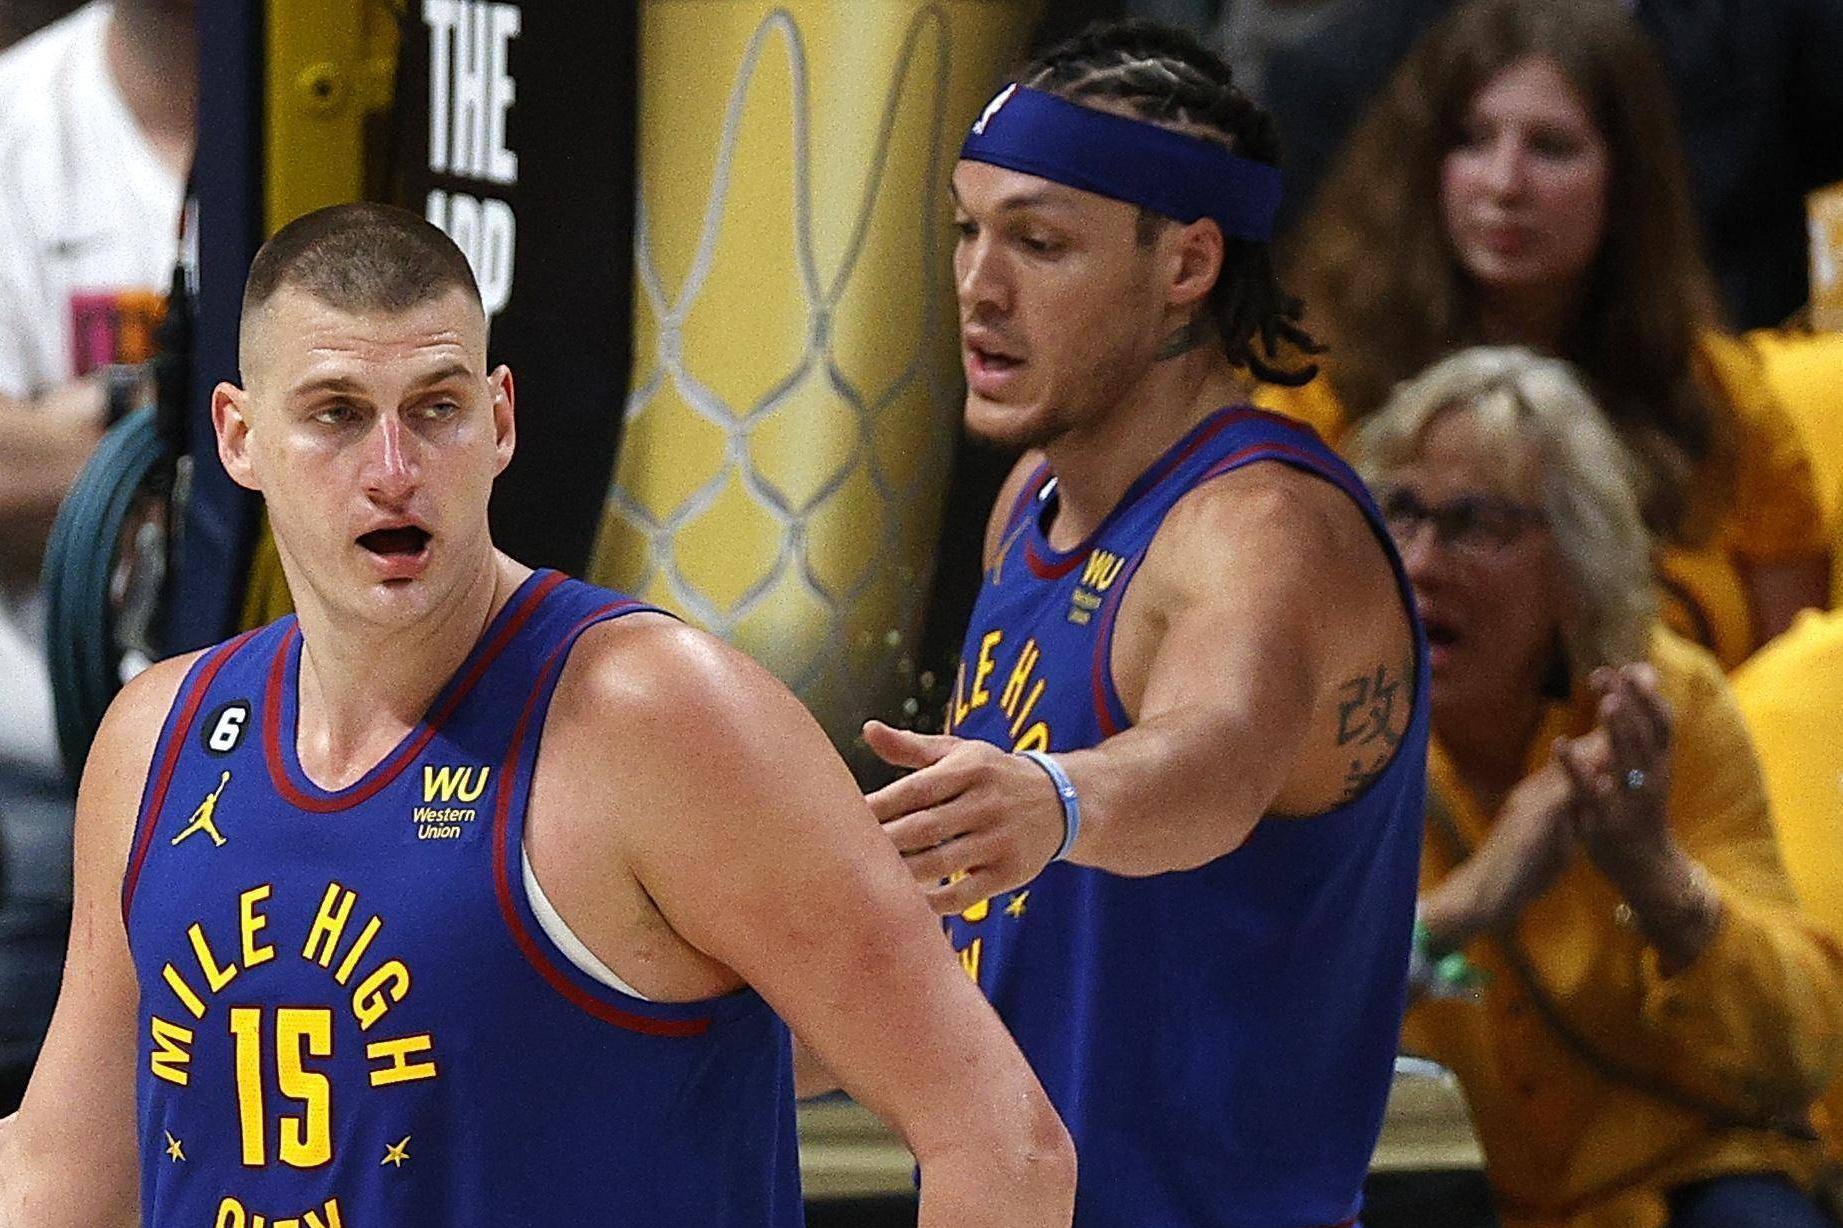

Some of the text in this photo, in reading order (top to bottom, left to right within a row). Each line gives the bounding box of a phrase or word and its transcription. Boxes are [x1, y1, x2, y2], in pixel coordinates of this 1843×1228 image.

[421, 0, 522, 184] THE
[209, 707, 247, 751] 6
[424, 766, 491, 802] WU
[414, 807, 476, 823] Western
[418, 822, 461, 840] Union
[151, 881, 437, 1087] MILE HIGH
[228, 1005, 333, 1170] 15
